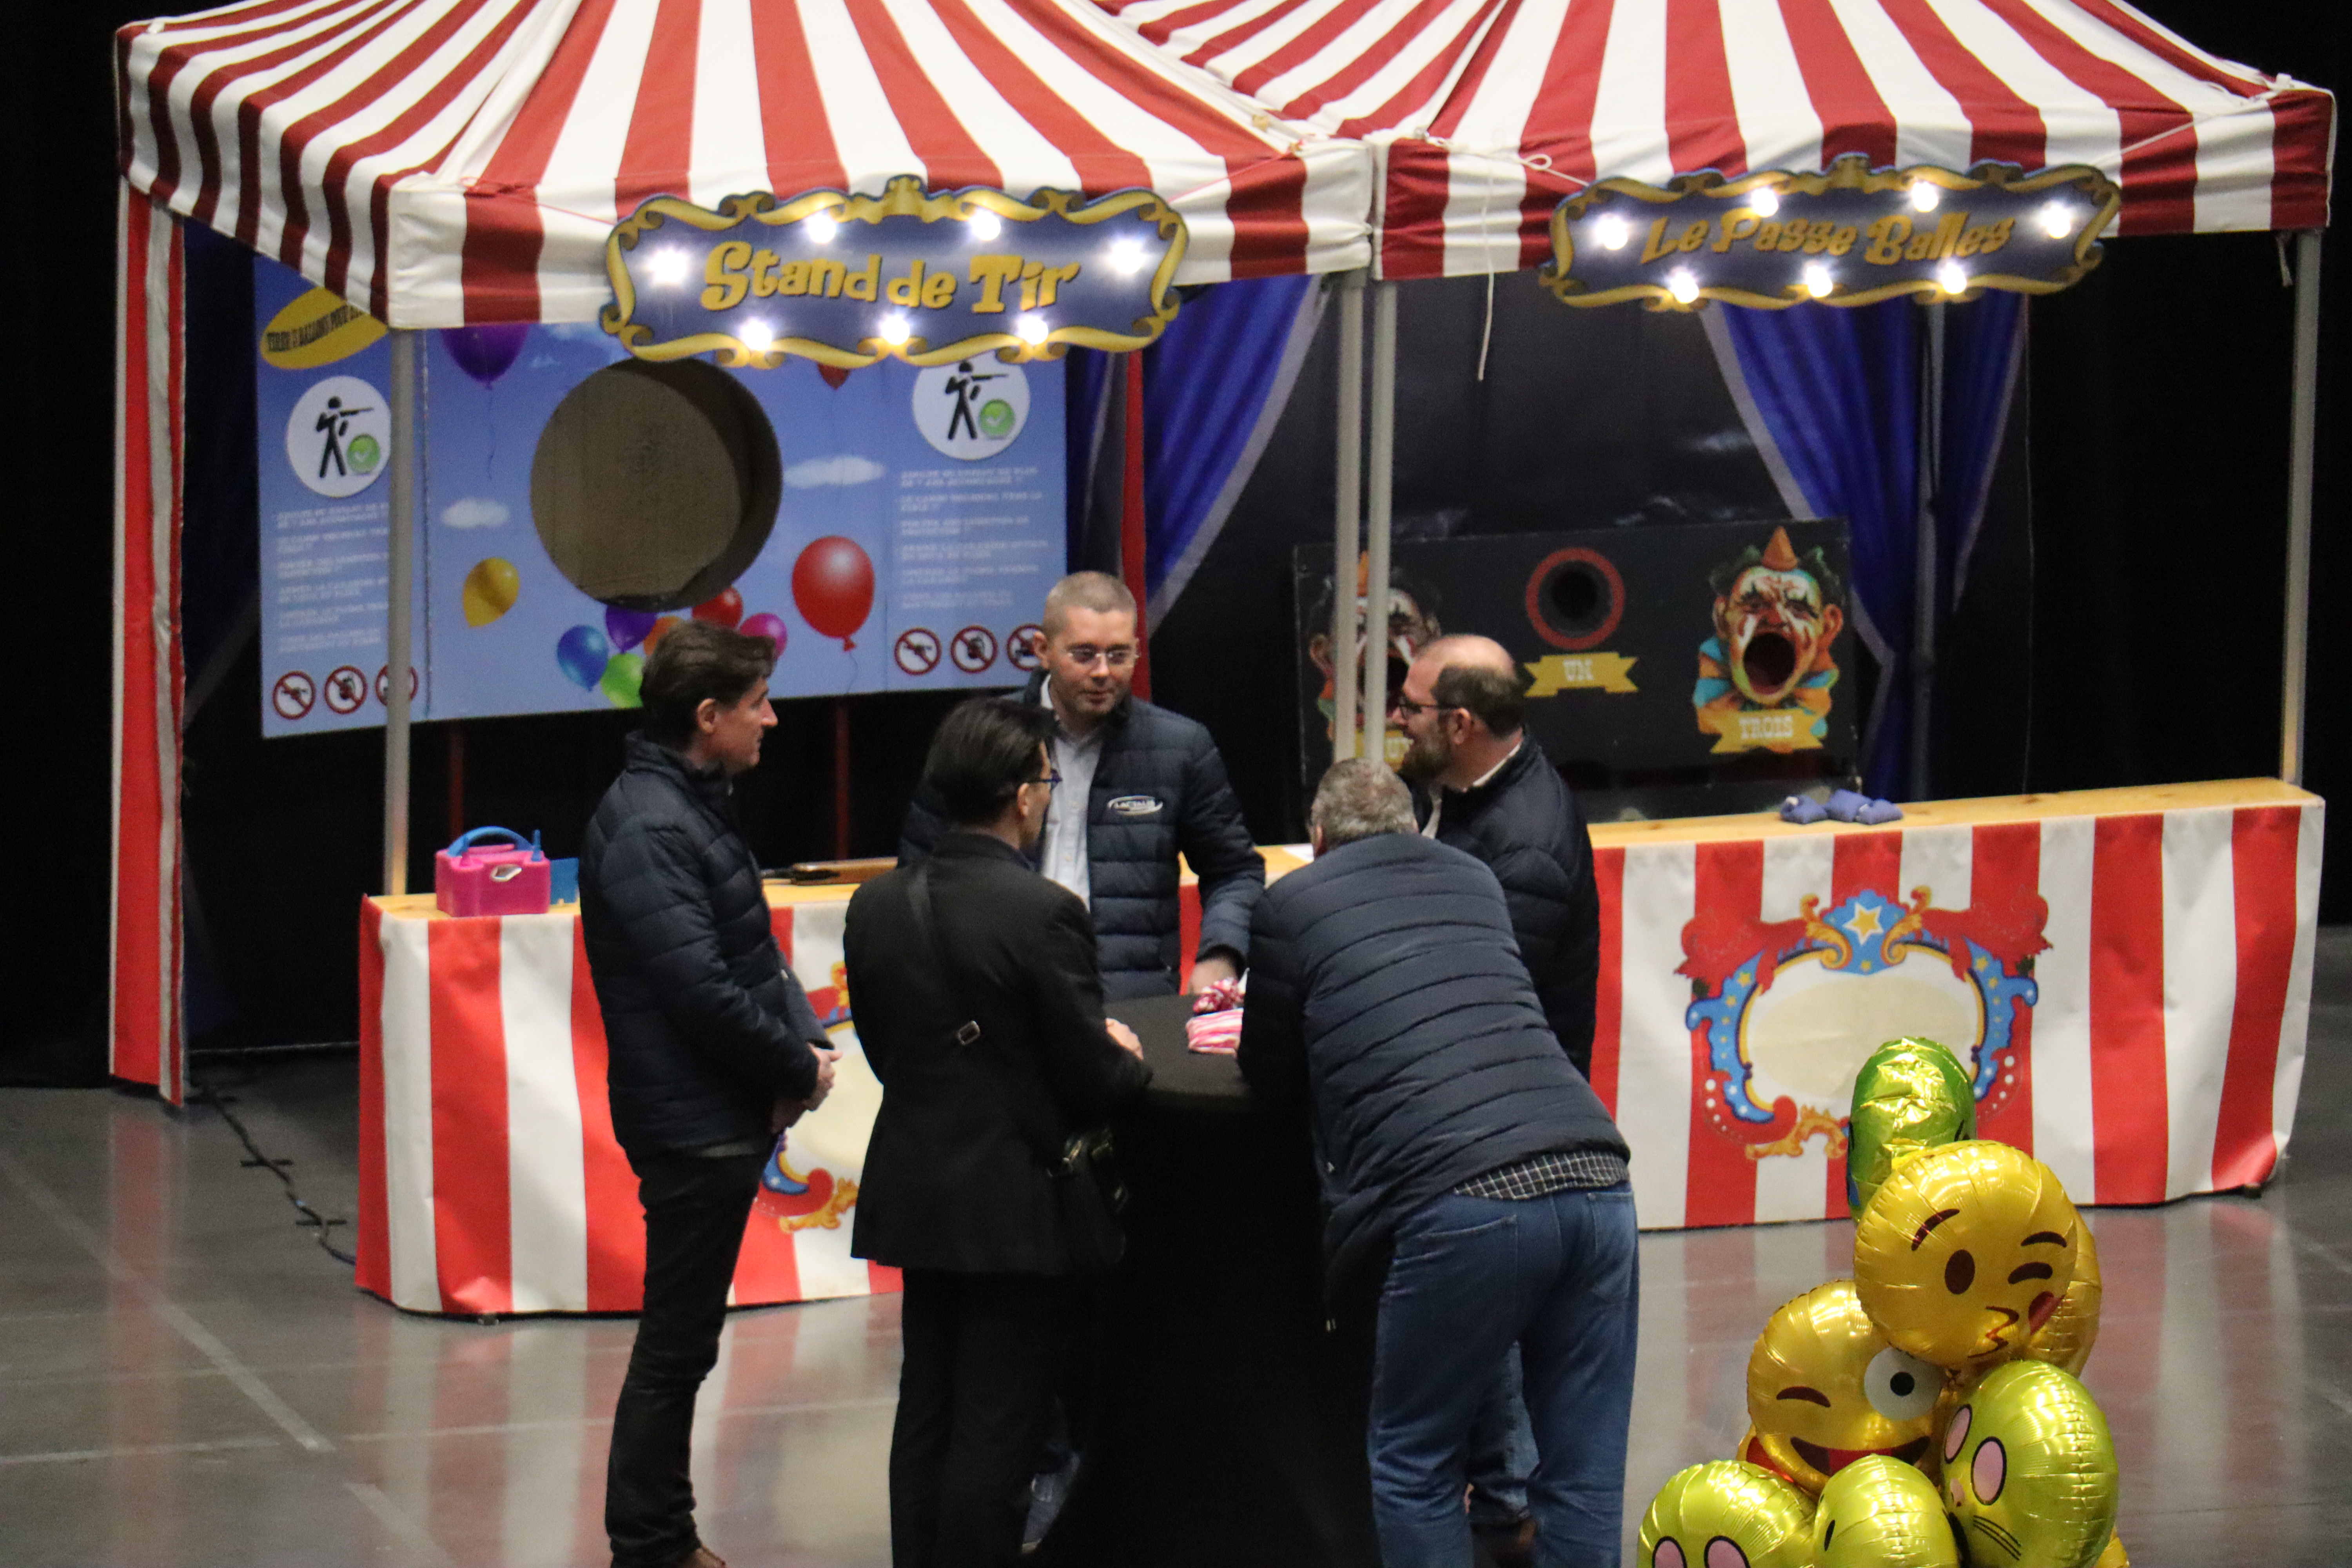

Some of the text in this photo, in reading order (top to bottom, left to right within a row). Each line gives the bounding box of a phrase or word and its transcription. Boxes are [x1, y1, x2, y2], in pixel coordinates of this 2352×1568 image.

[1641, 205, 2015, 265] Le Passe Balles
[701, 241, 1081, 314] Stand de Tir
[1739, 715, 1793, 739] TROIS
